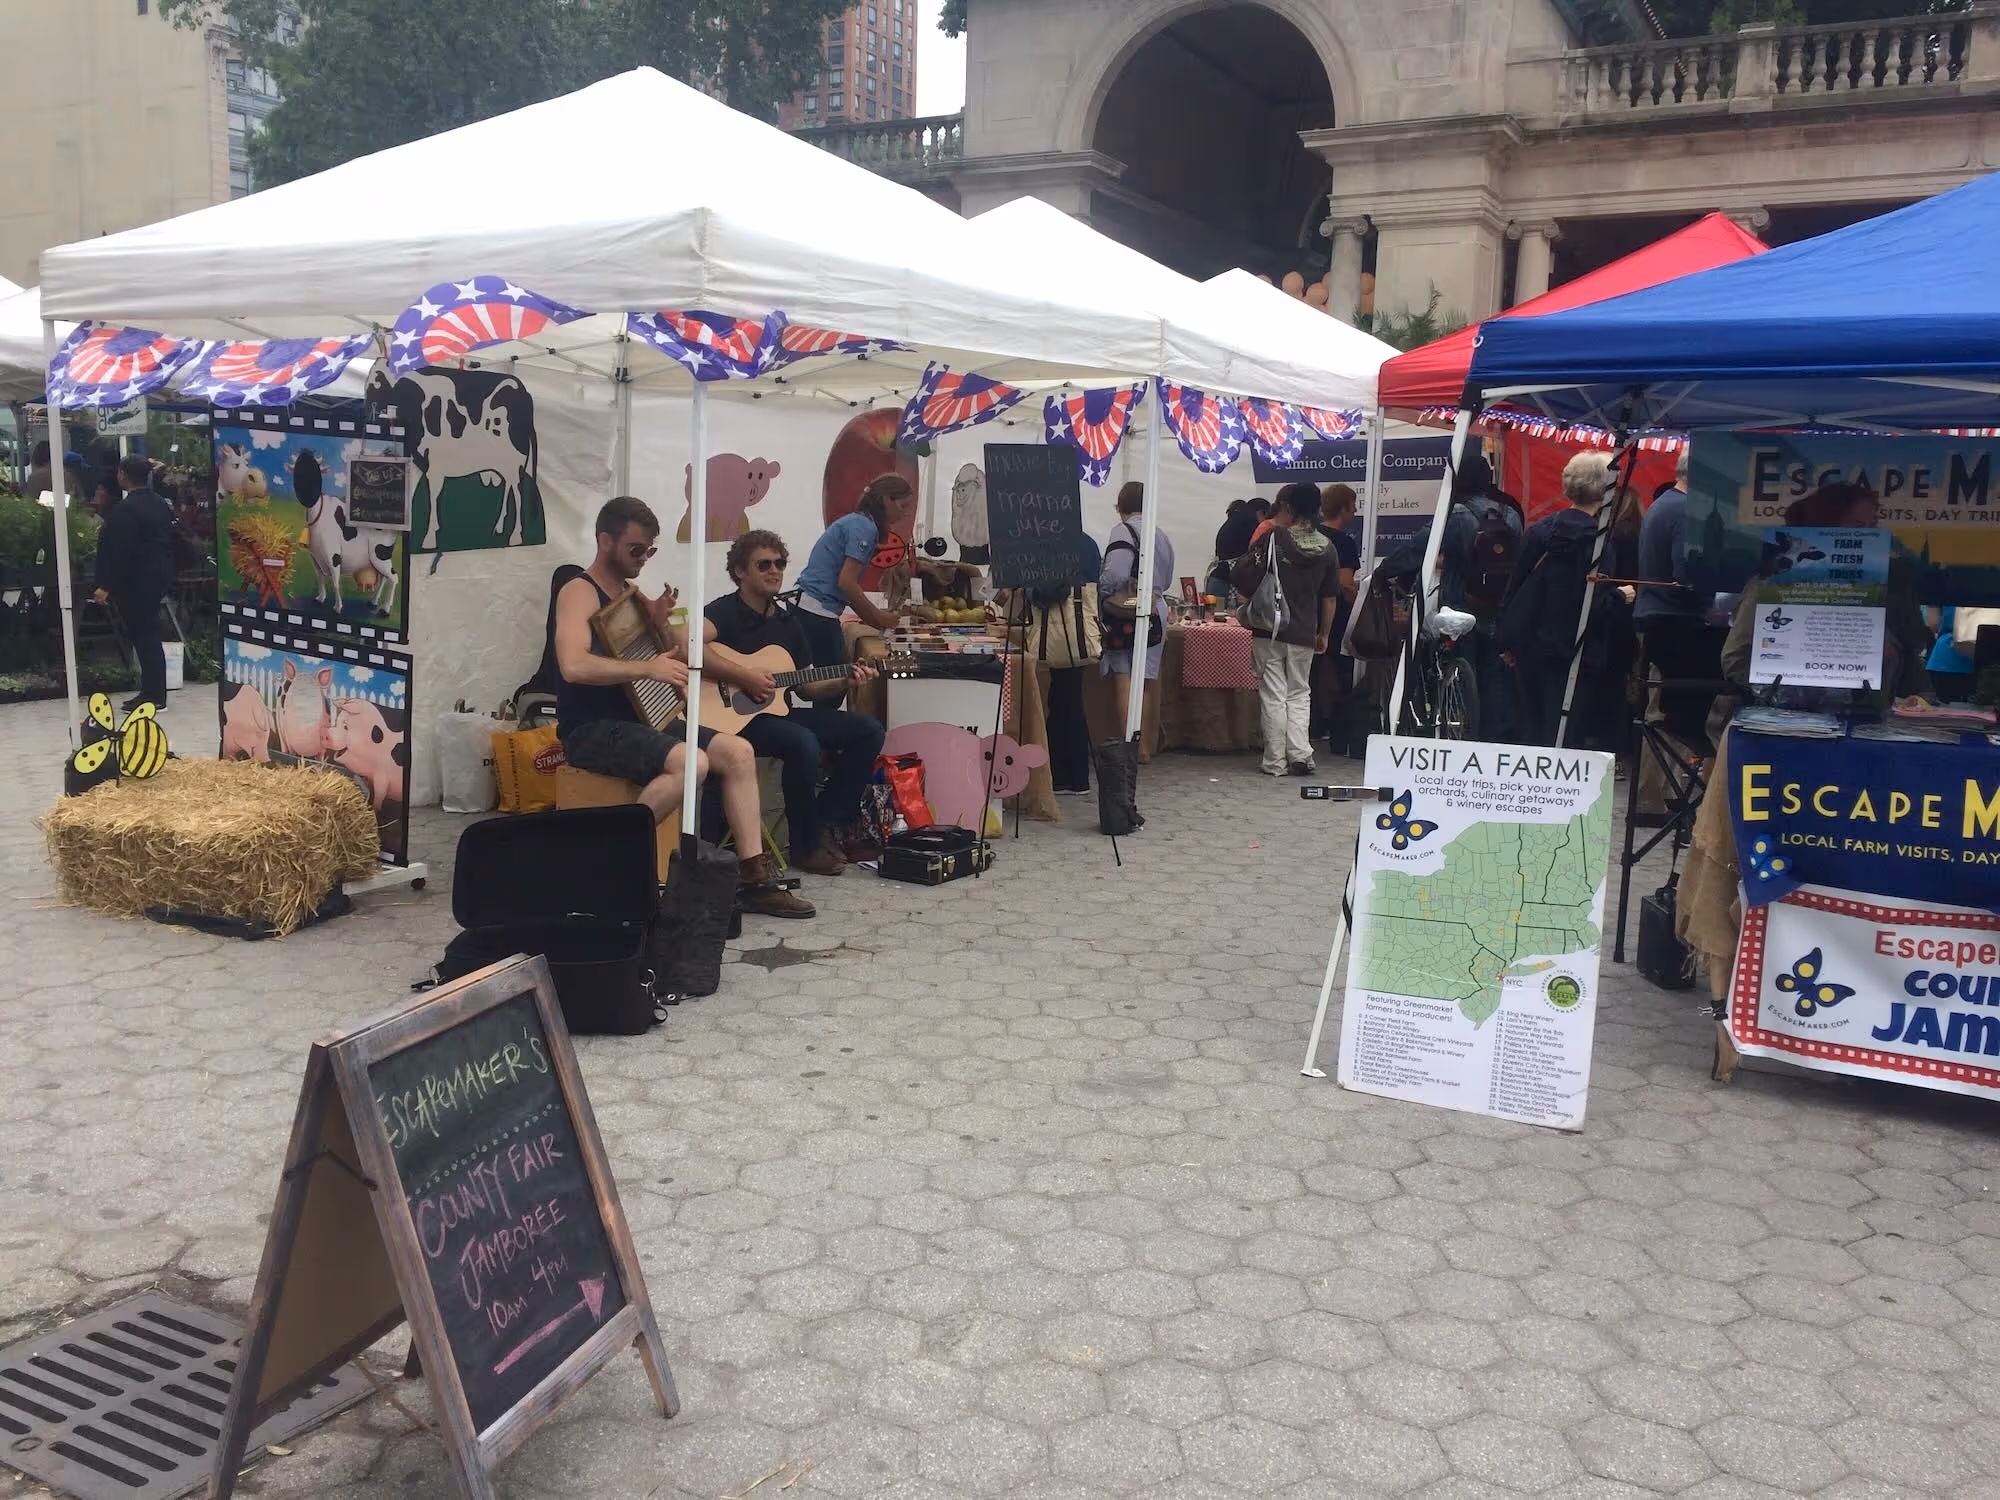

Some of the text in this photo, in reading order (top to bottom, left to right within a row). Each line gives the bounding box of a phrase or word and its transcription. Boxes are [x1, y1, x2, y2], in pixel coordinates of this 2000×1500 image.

[1277, 453, 1448, 470] mino Chee Company
[1948, 453, 2000, 505] M
[1392, 497, 1420, 509] Lakes
[1755, 505, 1788, 517] LOC
[1879, 508, 1918, 521] SITS,
[1926, 509, 1962, 521] DAY
[1834, 539, 1862, 549] FARM
[1831, 554, 1864, 565] FRESH
[1805, 663, 1867, 672] BOOK NOW!
[1390, 746, 1590, 783] VISIT A FARM!
[1414, 774, 1580, 796] Local day trips, pick your own
[1418, 785, 1575, 808] orchards, culinary getaways
[1742, 764, 1942, 829] ESCAPE
[1446, 798, 1543, 815] & winery escapes
[1781, 833, 2000, 866] LOCAL FARM VISITS, DAY
[1506, 979, 1523, 987] NYC
[1365, 1003, 1393, 1013] farmers
[1395, 1006, 1410, 1016] and
[1367, 994, 1453, 1013] Featuring Greenmarket
[416, 1133, 563, 1258] COUNTY FAIR
[459, 1199, 566, 1310] JAMBOREE
